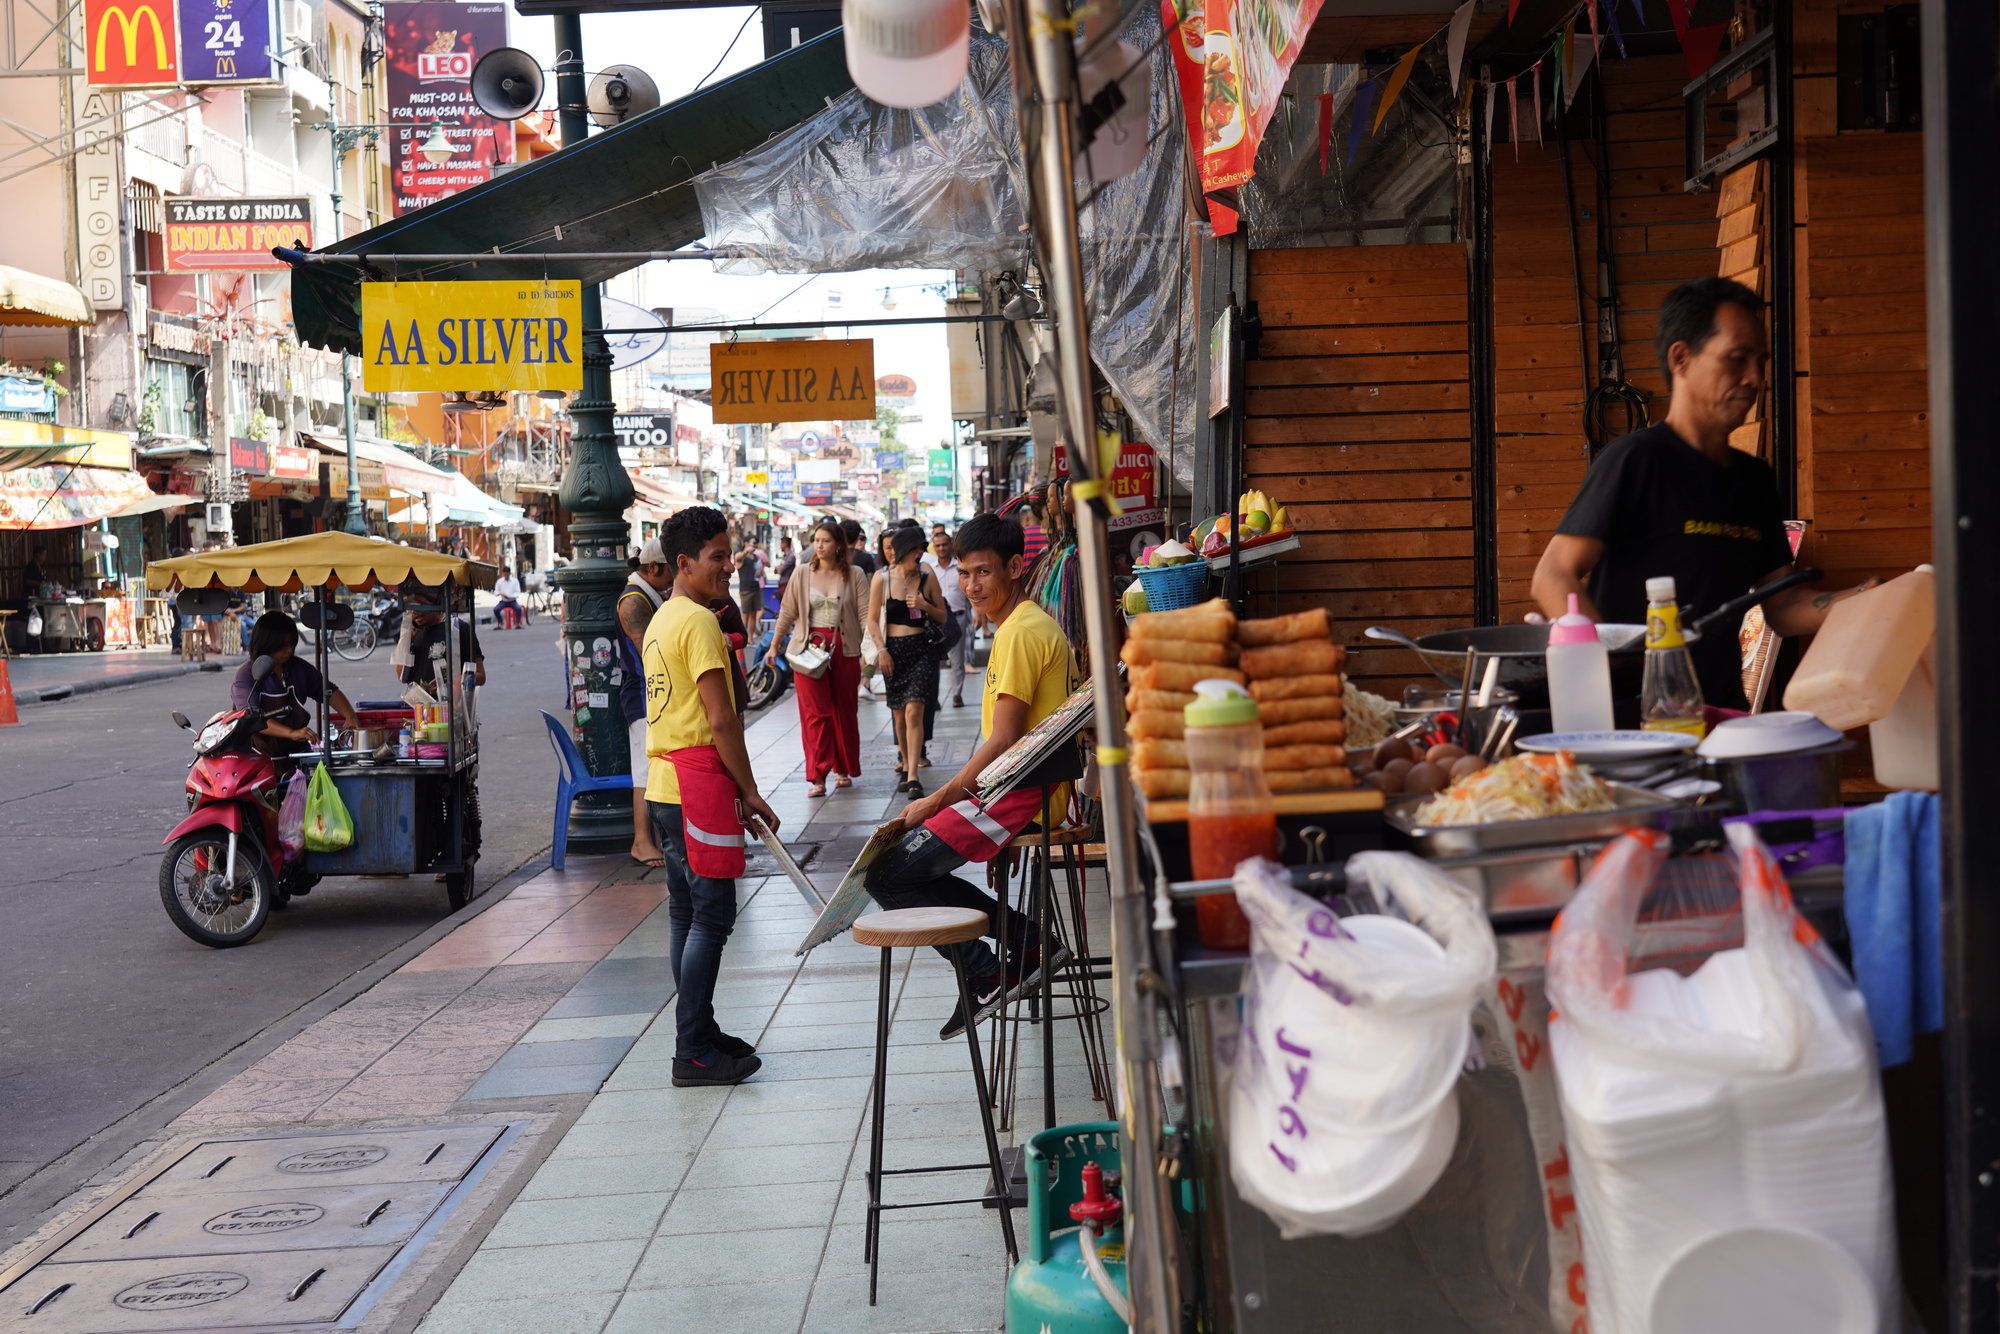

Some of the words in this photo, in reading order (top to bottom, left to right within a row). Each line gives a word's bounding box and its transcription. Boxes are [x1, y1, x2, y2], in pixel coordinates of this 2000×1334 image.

[204, 20, 244, 49] 24
[421, 55, 468, 76] LEO
[409, 92, 456, 104] MUST-DO
[459, 92, 475, 102] LIS
[392, 107, 414, 118] FOR
[415, 106, 466, 117] KHAOSAN
[472, 129, 494, 137] FOOD
[417, 162, 437, 170] HAVE
[447, 161, 482, 170] MASSAGE
[417, 176, 446, 185] CHEERS
[448, 176, 466, 184] WITH
[468, 176, 484, 184] LEO
[174, 205, 226, 221] TASTE
[229, 206, 250, 220] OF
[254, 203, 303, 220] INDIA
[87, 176, 116, 302] FOOD
[170, 225, 247, 251] INDIAN
[251, 224, 308, 250] FOOD
[374, 319, 430, 366] AA
[437, 317, 573, 365] SILVER
[823, 446, 853, 458] Buddy
